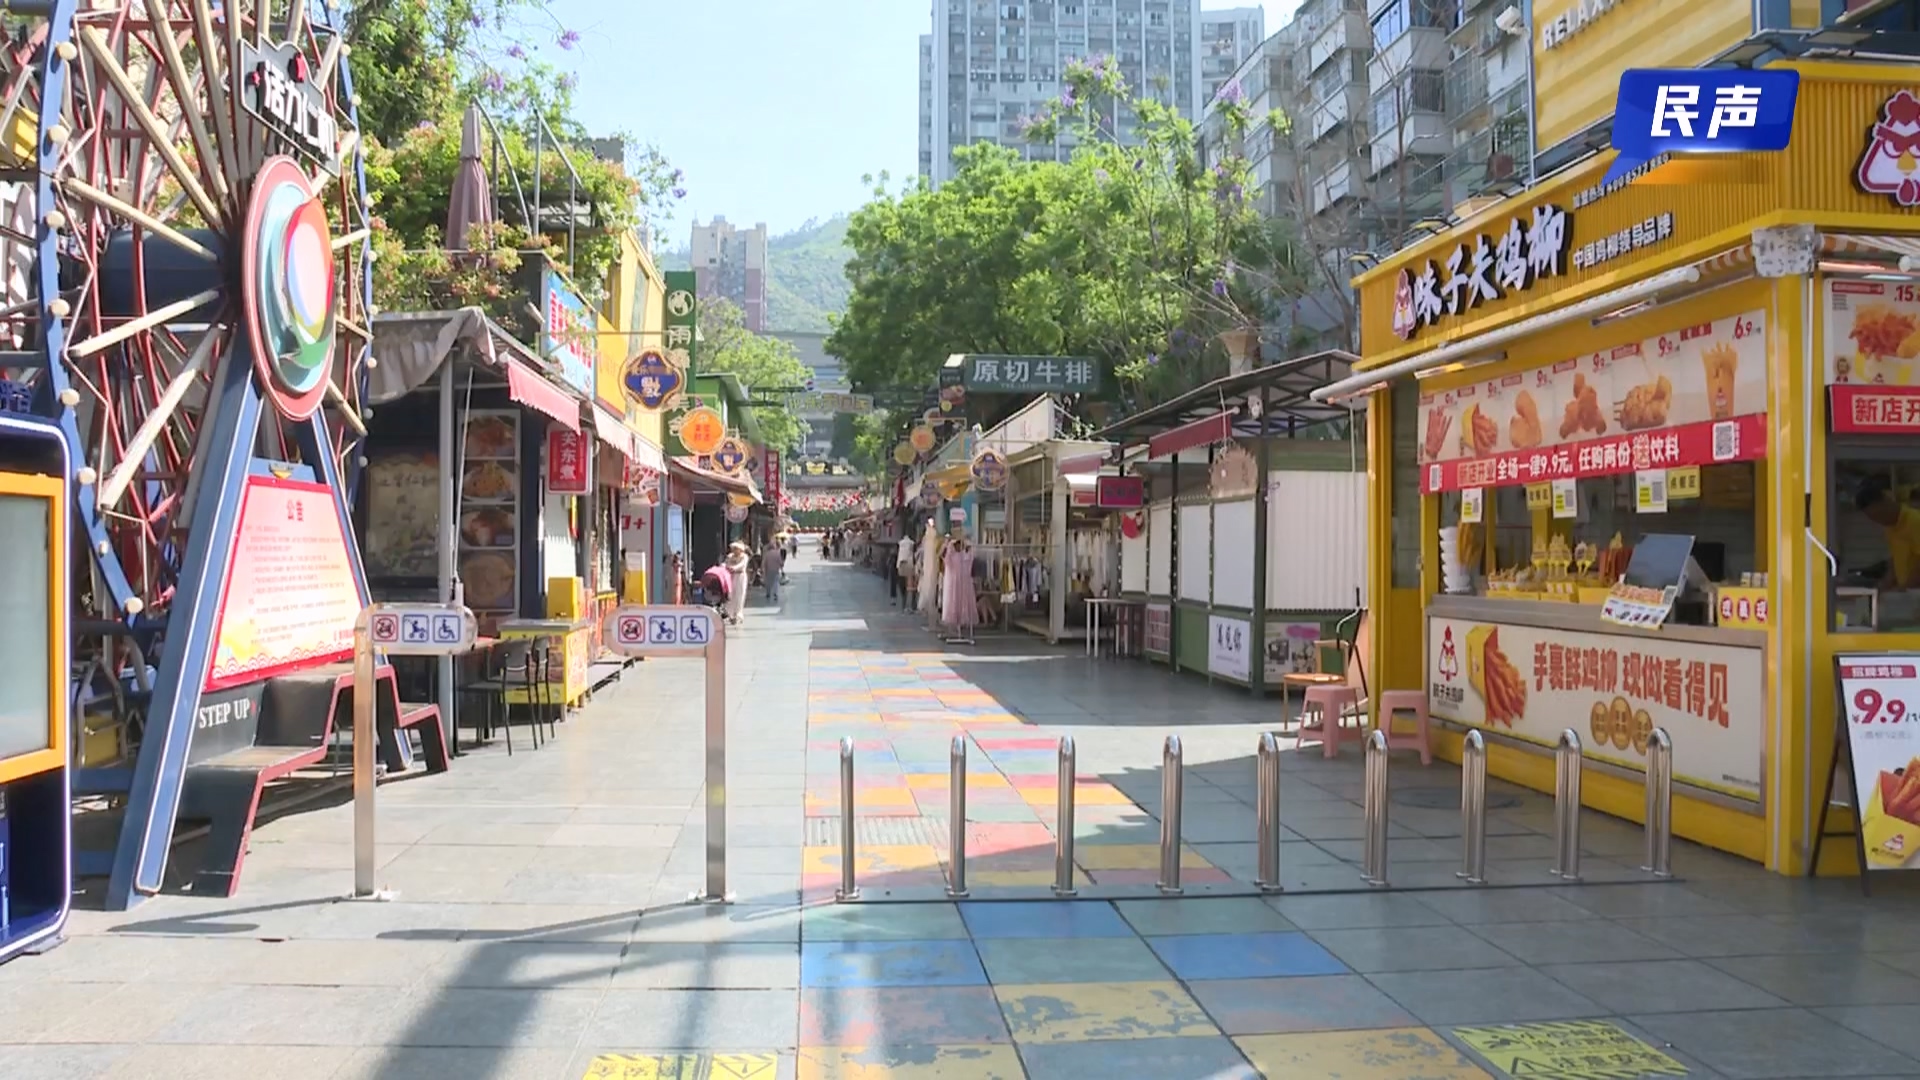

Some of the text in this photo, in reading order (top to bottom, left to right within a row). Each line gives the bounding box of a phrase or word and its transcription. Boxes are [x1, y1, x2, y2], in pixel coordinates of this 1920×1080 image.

[1573, 211, 1672, 271] 中国鸡柳领导品牌
[972, 359, 1093, 384] 原切牛排
[560, 431, 577, 480] 关东煮
[1534, 641, 1618, 693] 手裹鲜鸡柳
[1623, 651, 1729, 728] 现做看得见
[199, 697, 251, 729] STEP UP
